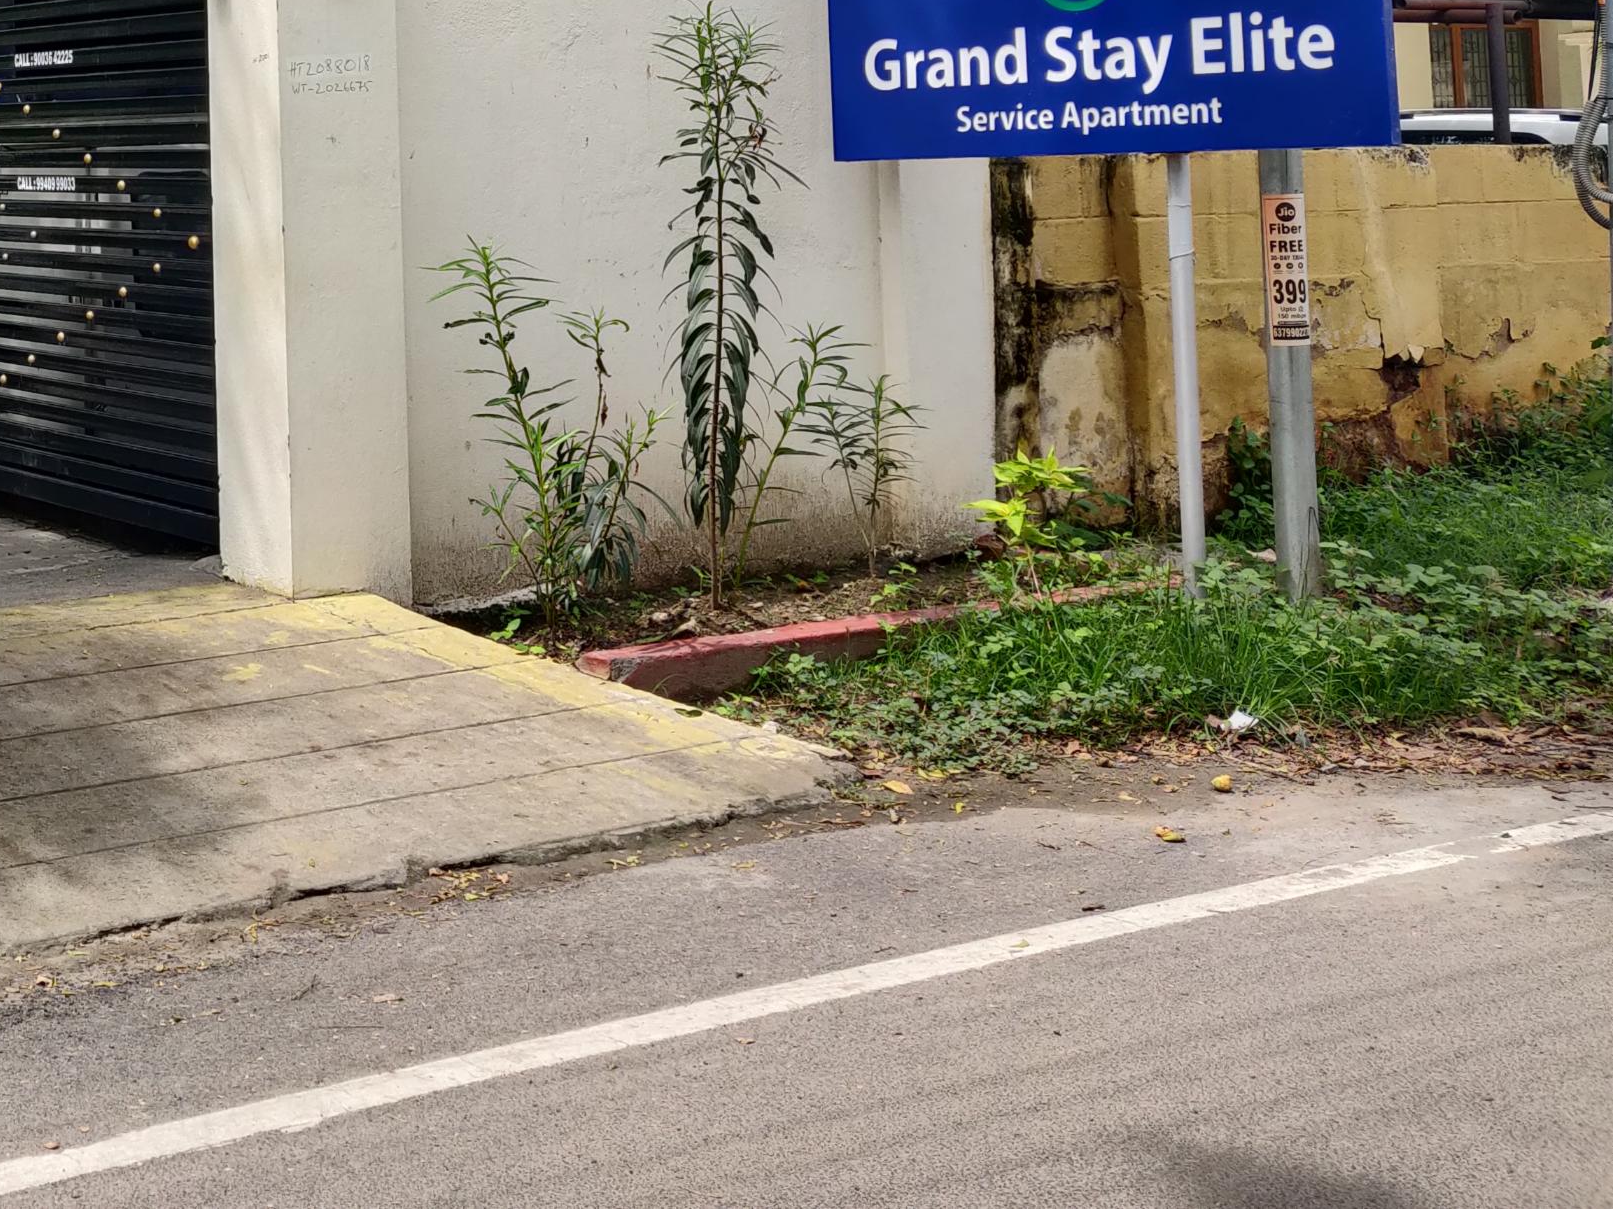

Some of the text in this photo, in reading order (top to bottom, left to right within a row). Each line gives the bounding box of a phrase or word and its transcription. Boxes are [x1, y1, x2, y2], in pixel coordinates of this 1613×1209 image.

[863, 11, 1336, 94] Grand Stay Elite
[955, 96, 1223, 136] Service Apartment
[1277, 206, 1295, 217] Jio
[1269, 223, 1302, 236] Fiber
[1269, 240, 1304, 254] FREE
[1272, 279, 1306, 304] 399
